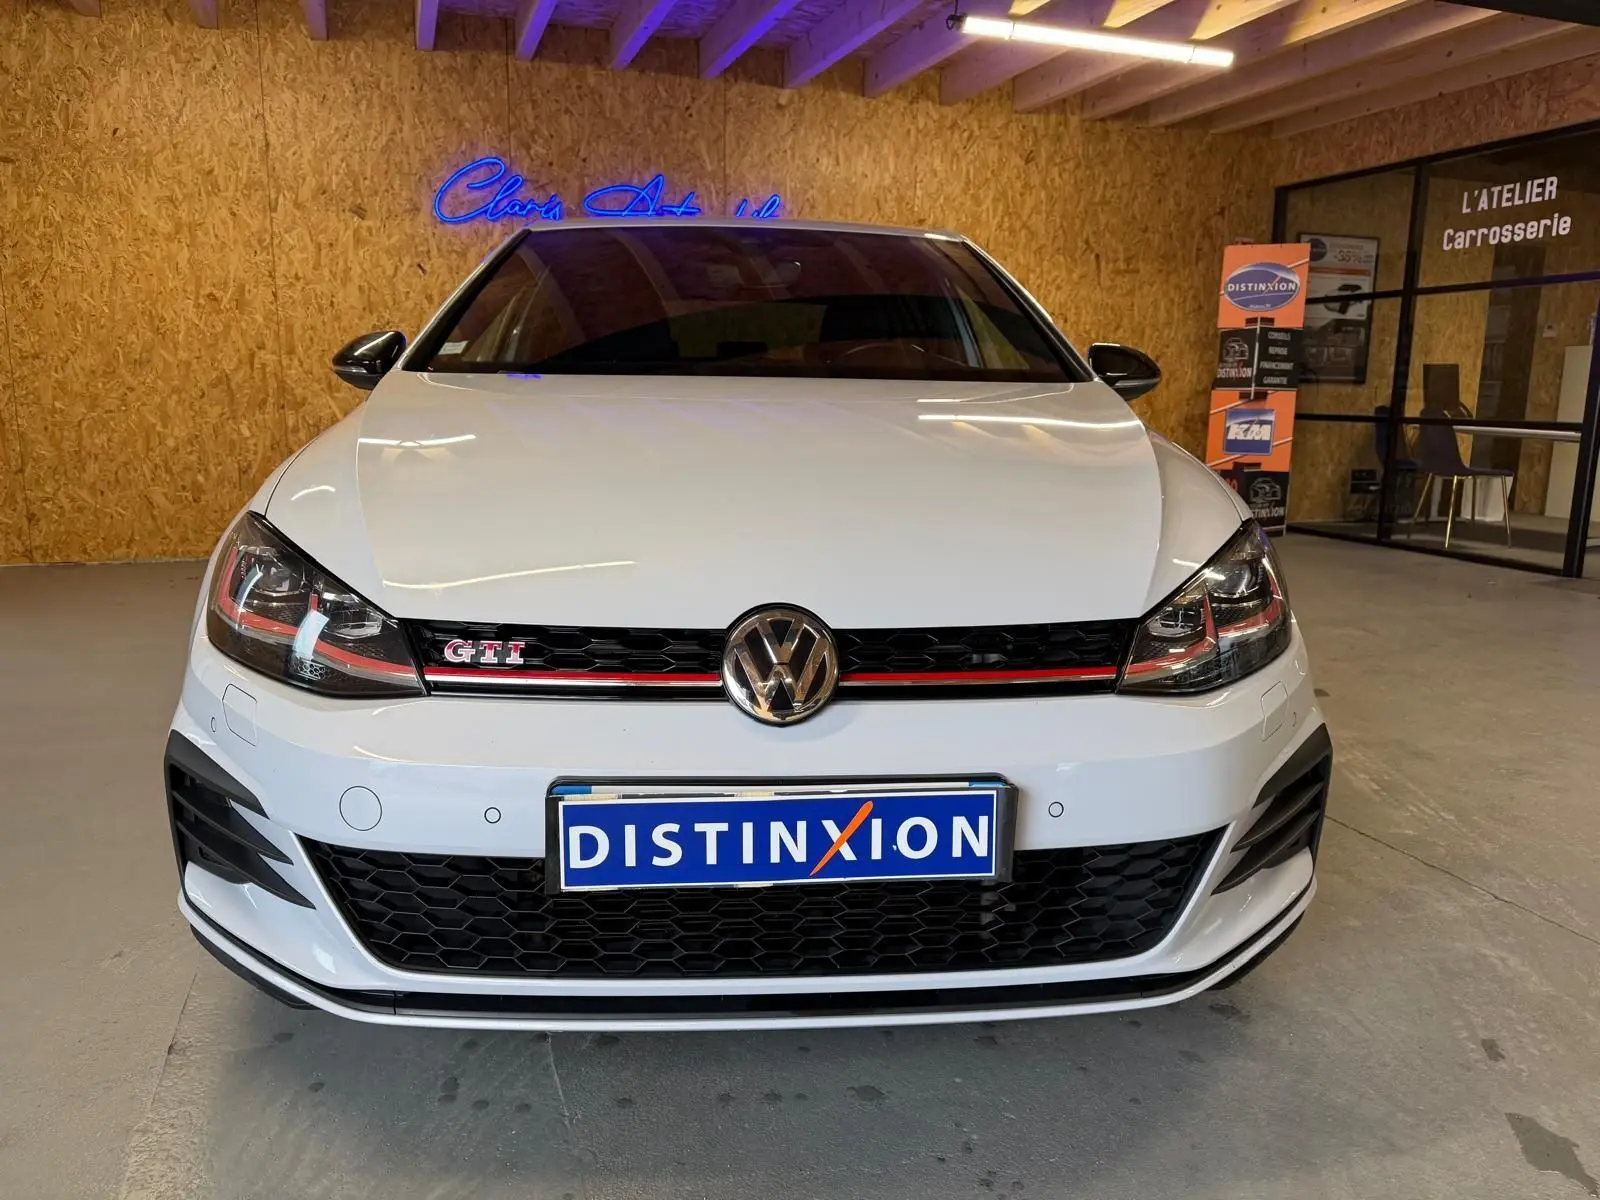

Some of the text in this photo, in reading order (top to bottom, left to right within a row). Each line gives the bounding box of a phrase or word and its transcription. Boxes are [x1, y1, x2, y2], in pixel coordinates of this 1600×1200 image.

[1461, 176, 1558, 214] L'ATELIER
[1443, 213, 1572, 251] Carrosserie
[1227, 279, 1296, 294] DISTINXION
[443, 638, 526, 665] GTI
[568, 803, 988, 875] DISTINXION
